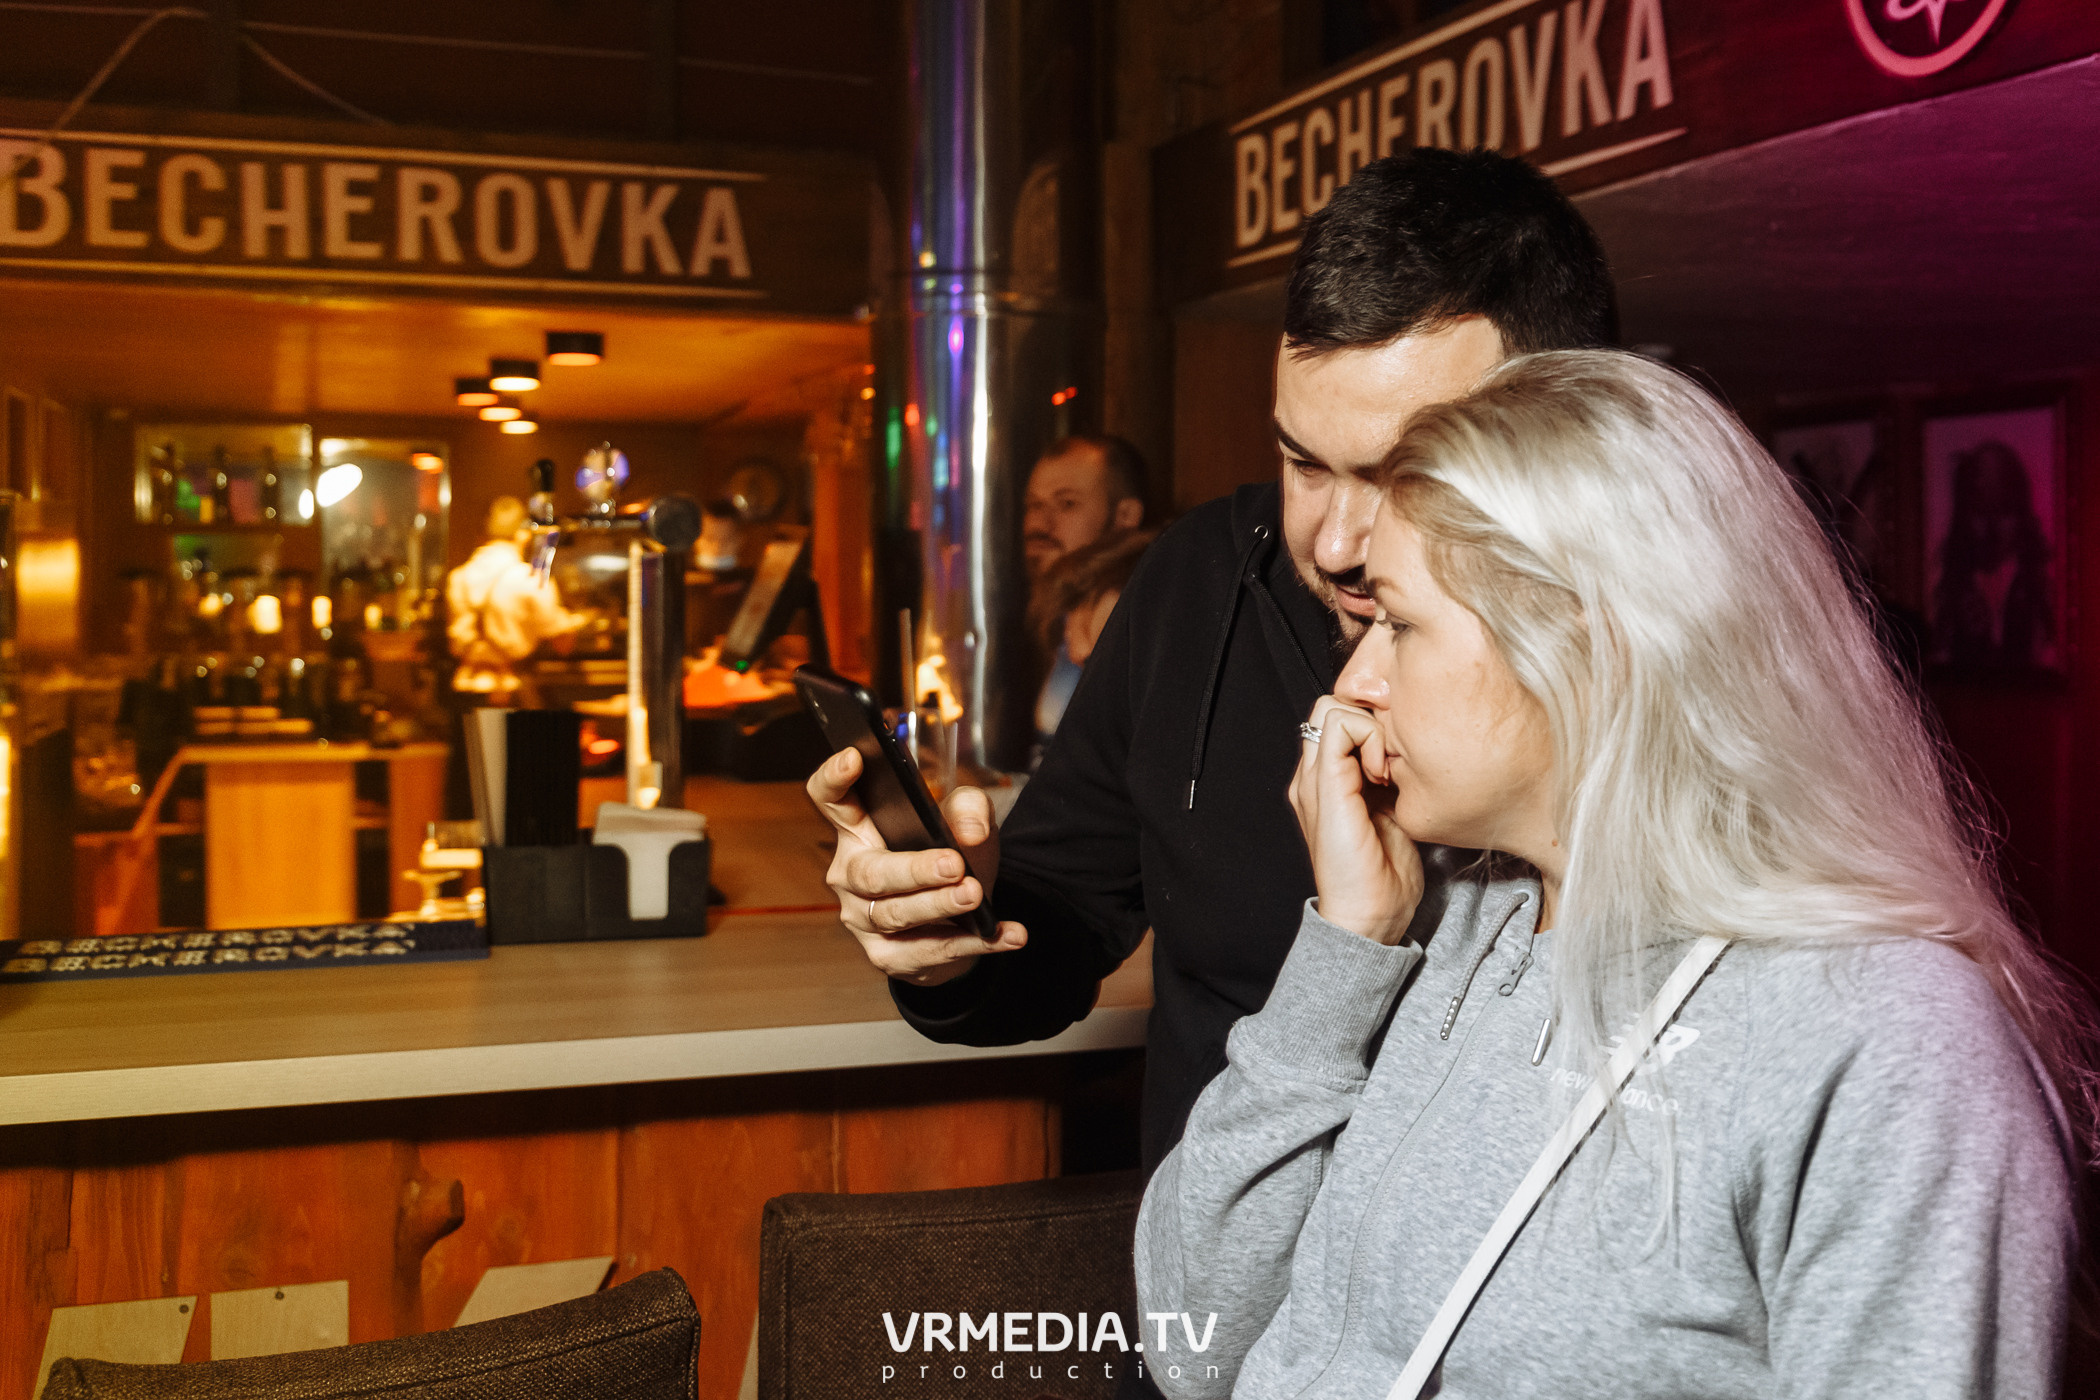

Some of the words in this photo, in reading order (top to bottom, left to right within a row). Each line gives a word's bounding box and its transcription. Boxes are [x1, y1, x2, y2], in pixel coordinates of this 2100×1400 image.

[1235, 0, 1674, 248] BECHEROVKA
[0, 138, 750, 279] BECHEROVKA
[1549, 1066, 1595, 1091] new
